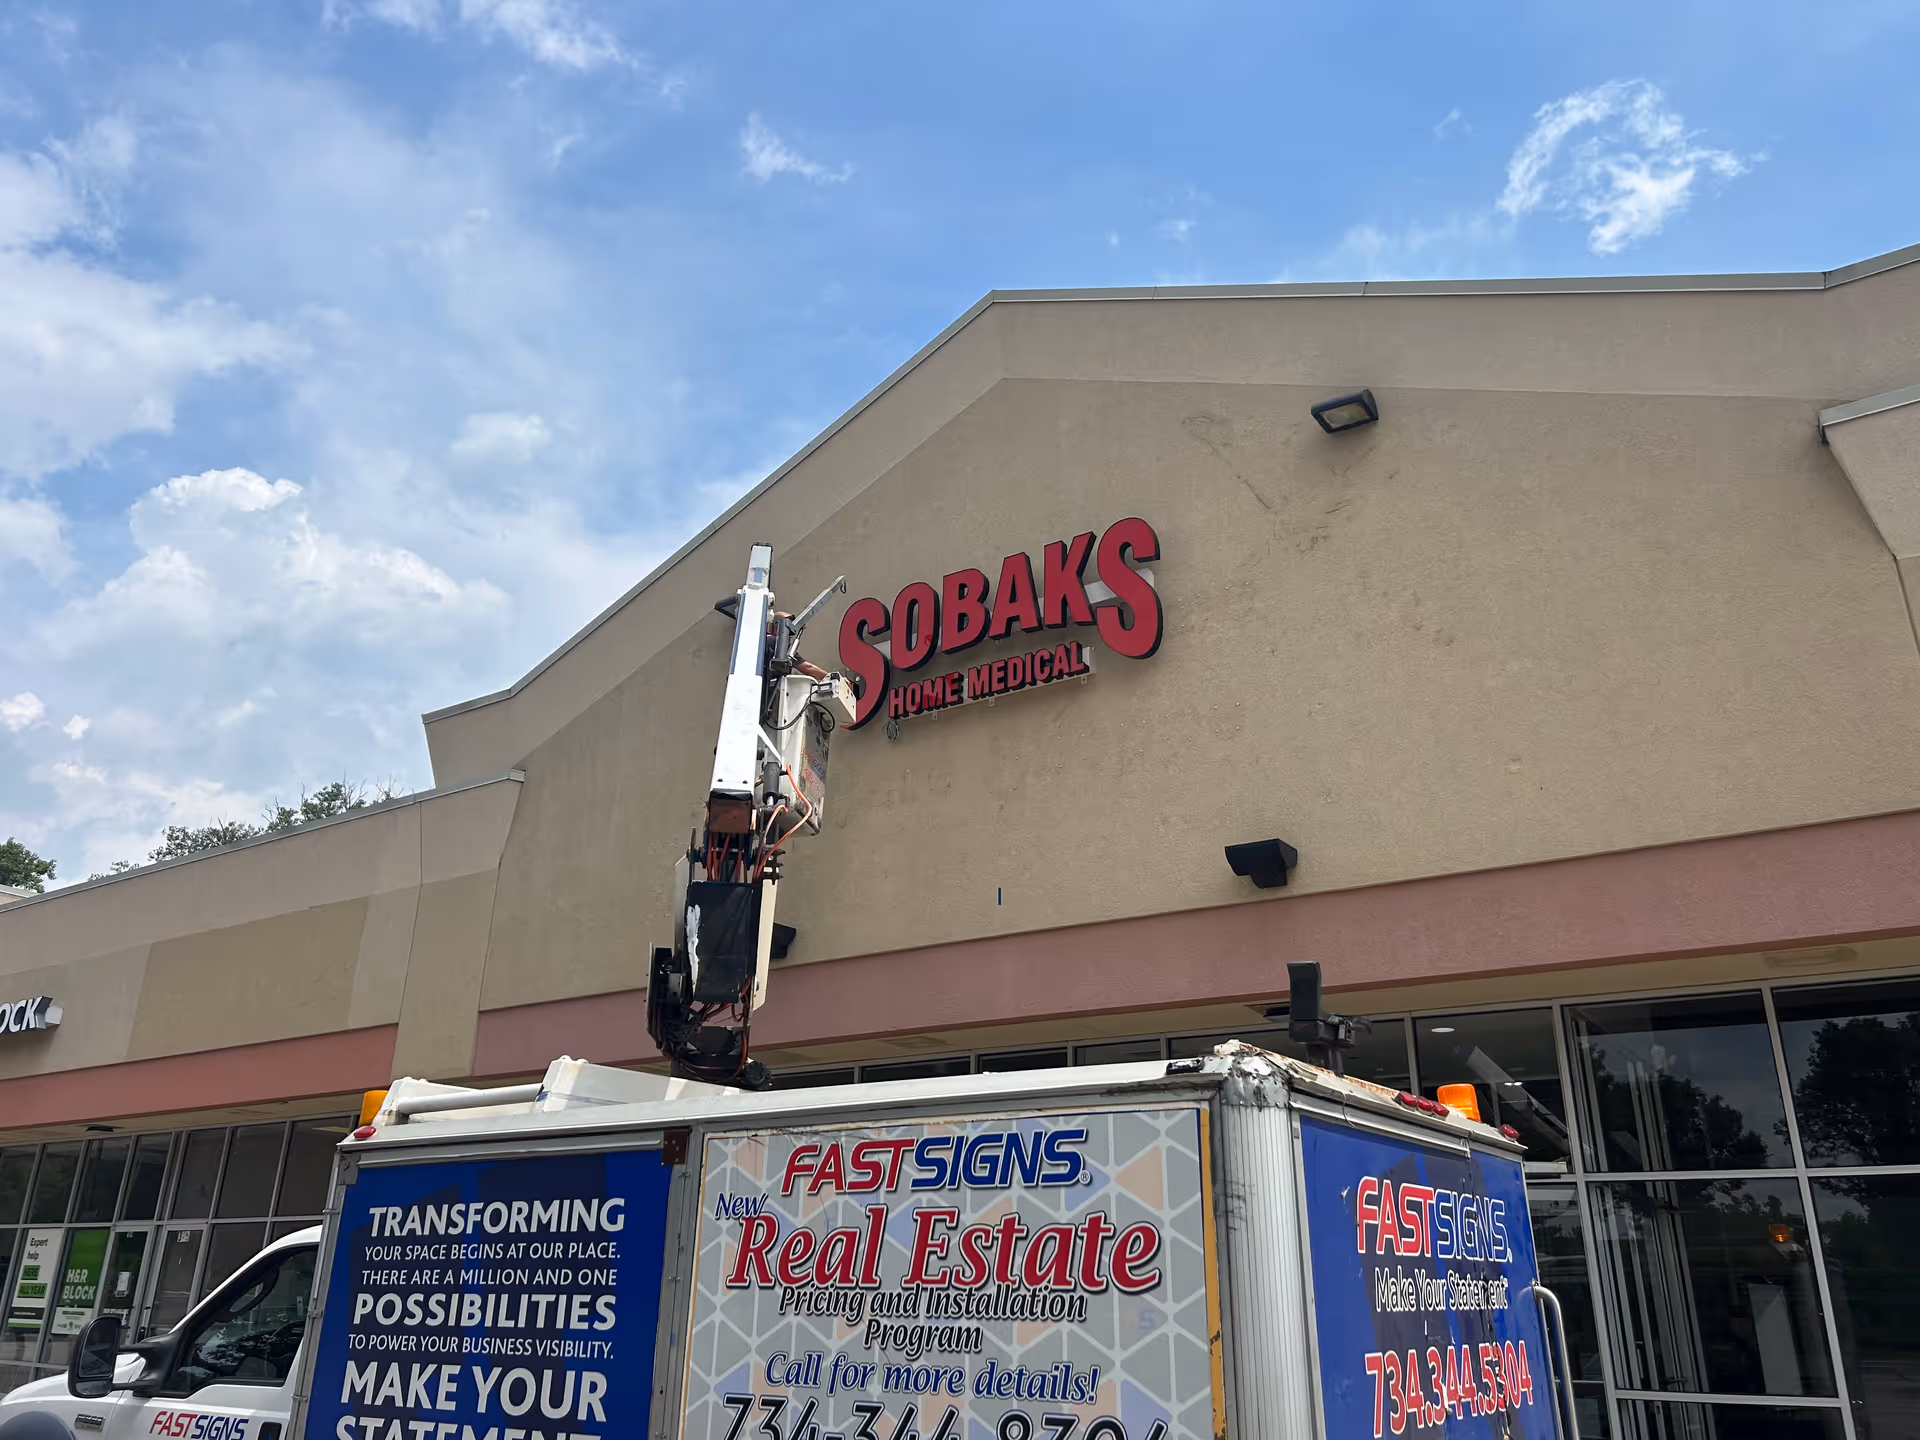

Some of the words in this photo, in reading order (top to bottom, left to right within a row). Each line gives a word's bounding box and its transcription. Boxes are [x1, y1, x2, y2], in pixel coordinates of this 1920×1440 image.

[838, 517, 1164, 730] SOBAKS
[889, 672, 963, 718] HOME
[967, 641, 1089, 700] MEDICAL
[369, 1197, 625, 1237] TRANSFORMING
[715, 1192, 768, 1219] New
[30, 1237, 48, 1248] Expert
[365, 1246, 401, 1261] YOUR
[405, 1245, 446, 1260] SPACE
[451, 1243, 503, 1259] BEGINS
[506, 1243, 526, 1259] AT
[529, 1242, 563, 1259] OUR
[568, 1242, 620, 1259] PLACE.
[726, 1203, 887, 1289] Real
[902, 1205, 1163, 1292] Estate
[63, 1285, 96, 1300] BLOCK
[66, 1269, 88, 1283] H&R
[362, 1270, 407, 1285] THERE
[411, 1269, 440, 1285] ARE
[444, 1270, 454, 1285] A
[459, 1269, 528, 1285] MILLION
[533, 1269, 572, 1285] AND
[578, 1269, 617, 1286] ONE
[1375, 1265, 1416, 1312] Make
[1415, 1269, 1446, 1311] Your
[353, 1293, 616, 1331] POSSIBILITIES
[779, 1283, 865, 1326] Pricing
[869, 1282, 922, 1319] and
[924, 1284, 1088, 1321] Installation
[349, 1334, 366, 1349] TO
[368, 1334, 416, 1351] POWER
[420, 1335, 458, 1353] YOUR
[462, 1336, 532, 1356] BUSINESS
[536, 1339, 615, 1360] VISIBILITY.
[862, 1318, 984, 1361] Program
[340, 1360, 461, 1411] MAKE
[471, 1366, 608, 1422] YOUR
[764, 1352, 823, 1388] Call
[827, 1353, 877, 1396] for
[882, 1361, 966, 1396] more
[972, 1359, 1102, 1404] details!
[149, 1411, 249, 1440] FASTSIGNS
